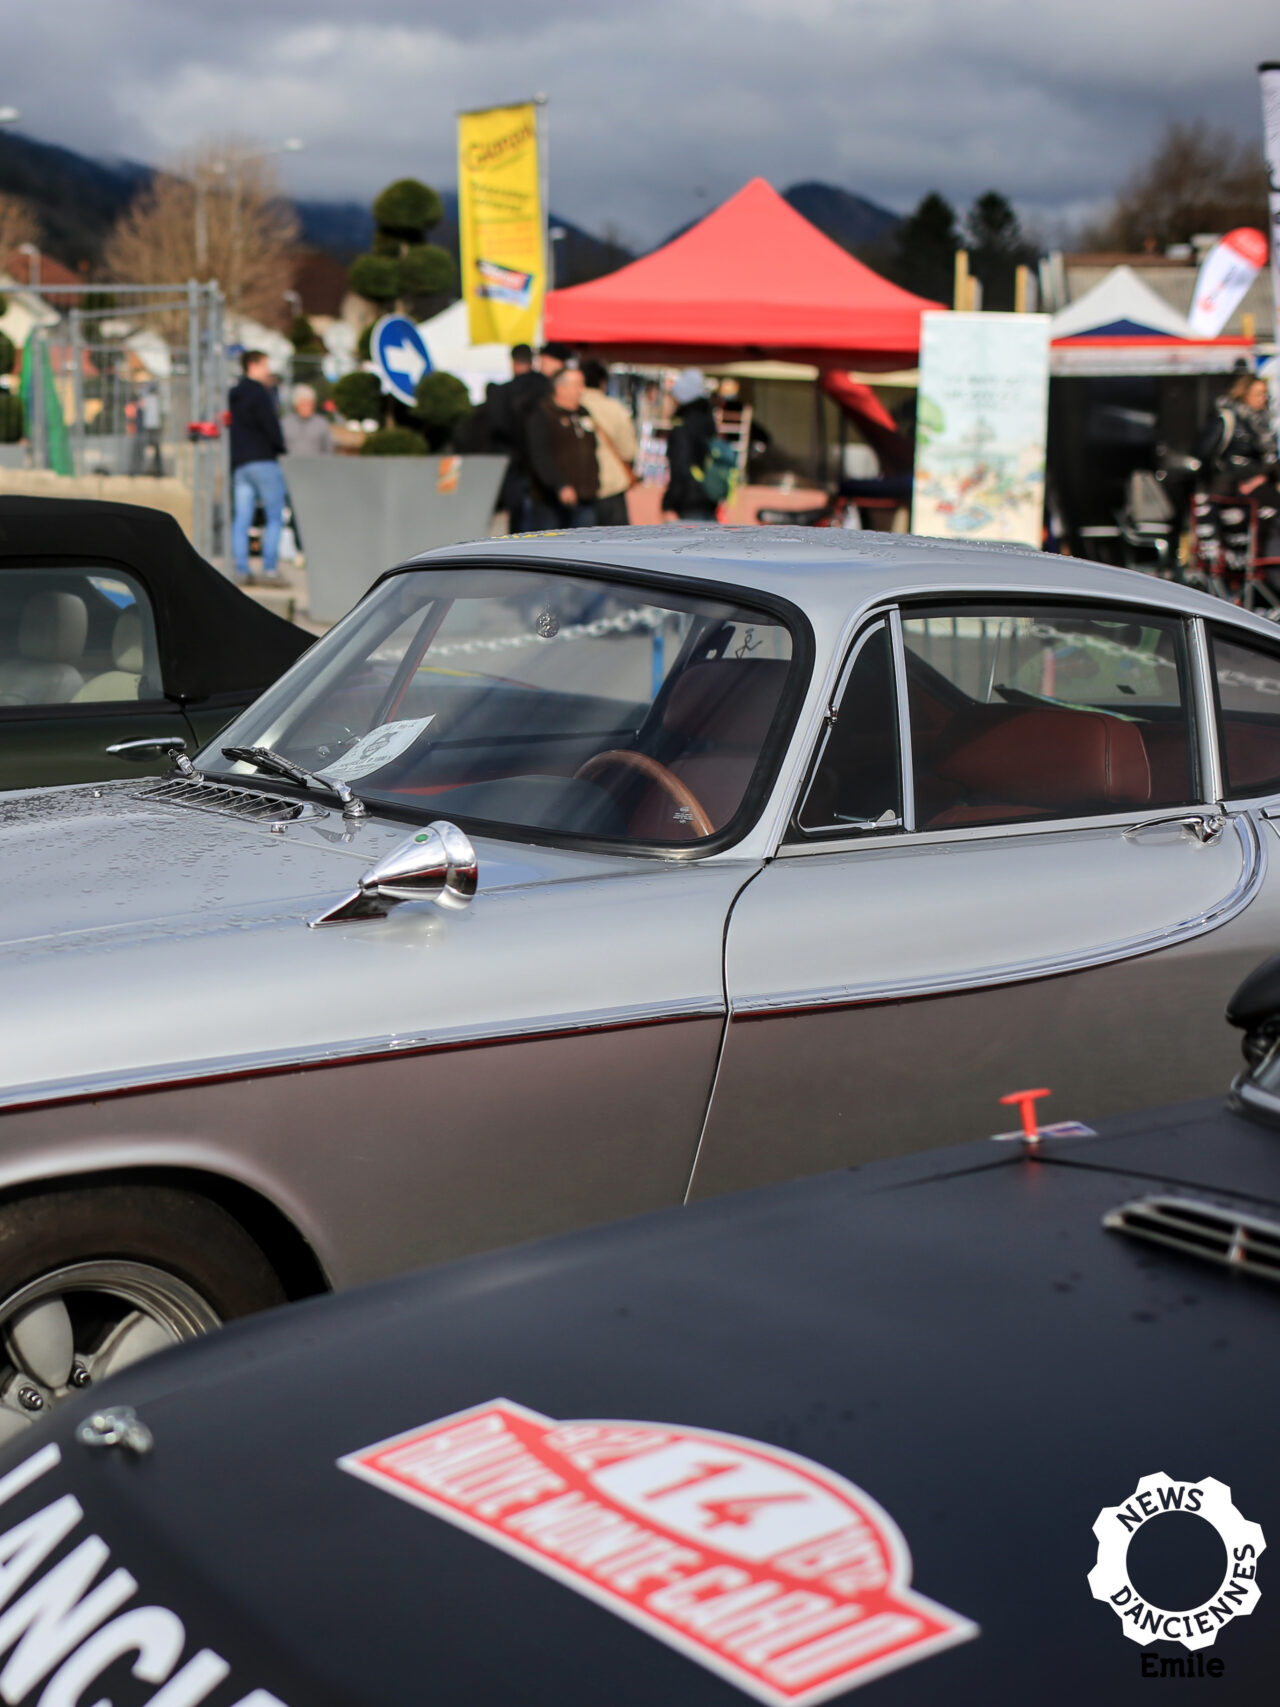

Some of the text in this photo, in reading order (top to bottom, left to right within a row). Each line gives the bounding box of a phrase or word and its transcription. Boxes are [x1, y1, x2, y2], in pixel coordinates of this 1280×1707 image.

[376, 1412, 925, 1687] RALLYE MONTE-CARLO
[641, 1460, 818, 1532] 14
